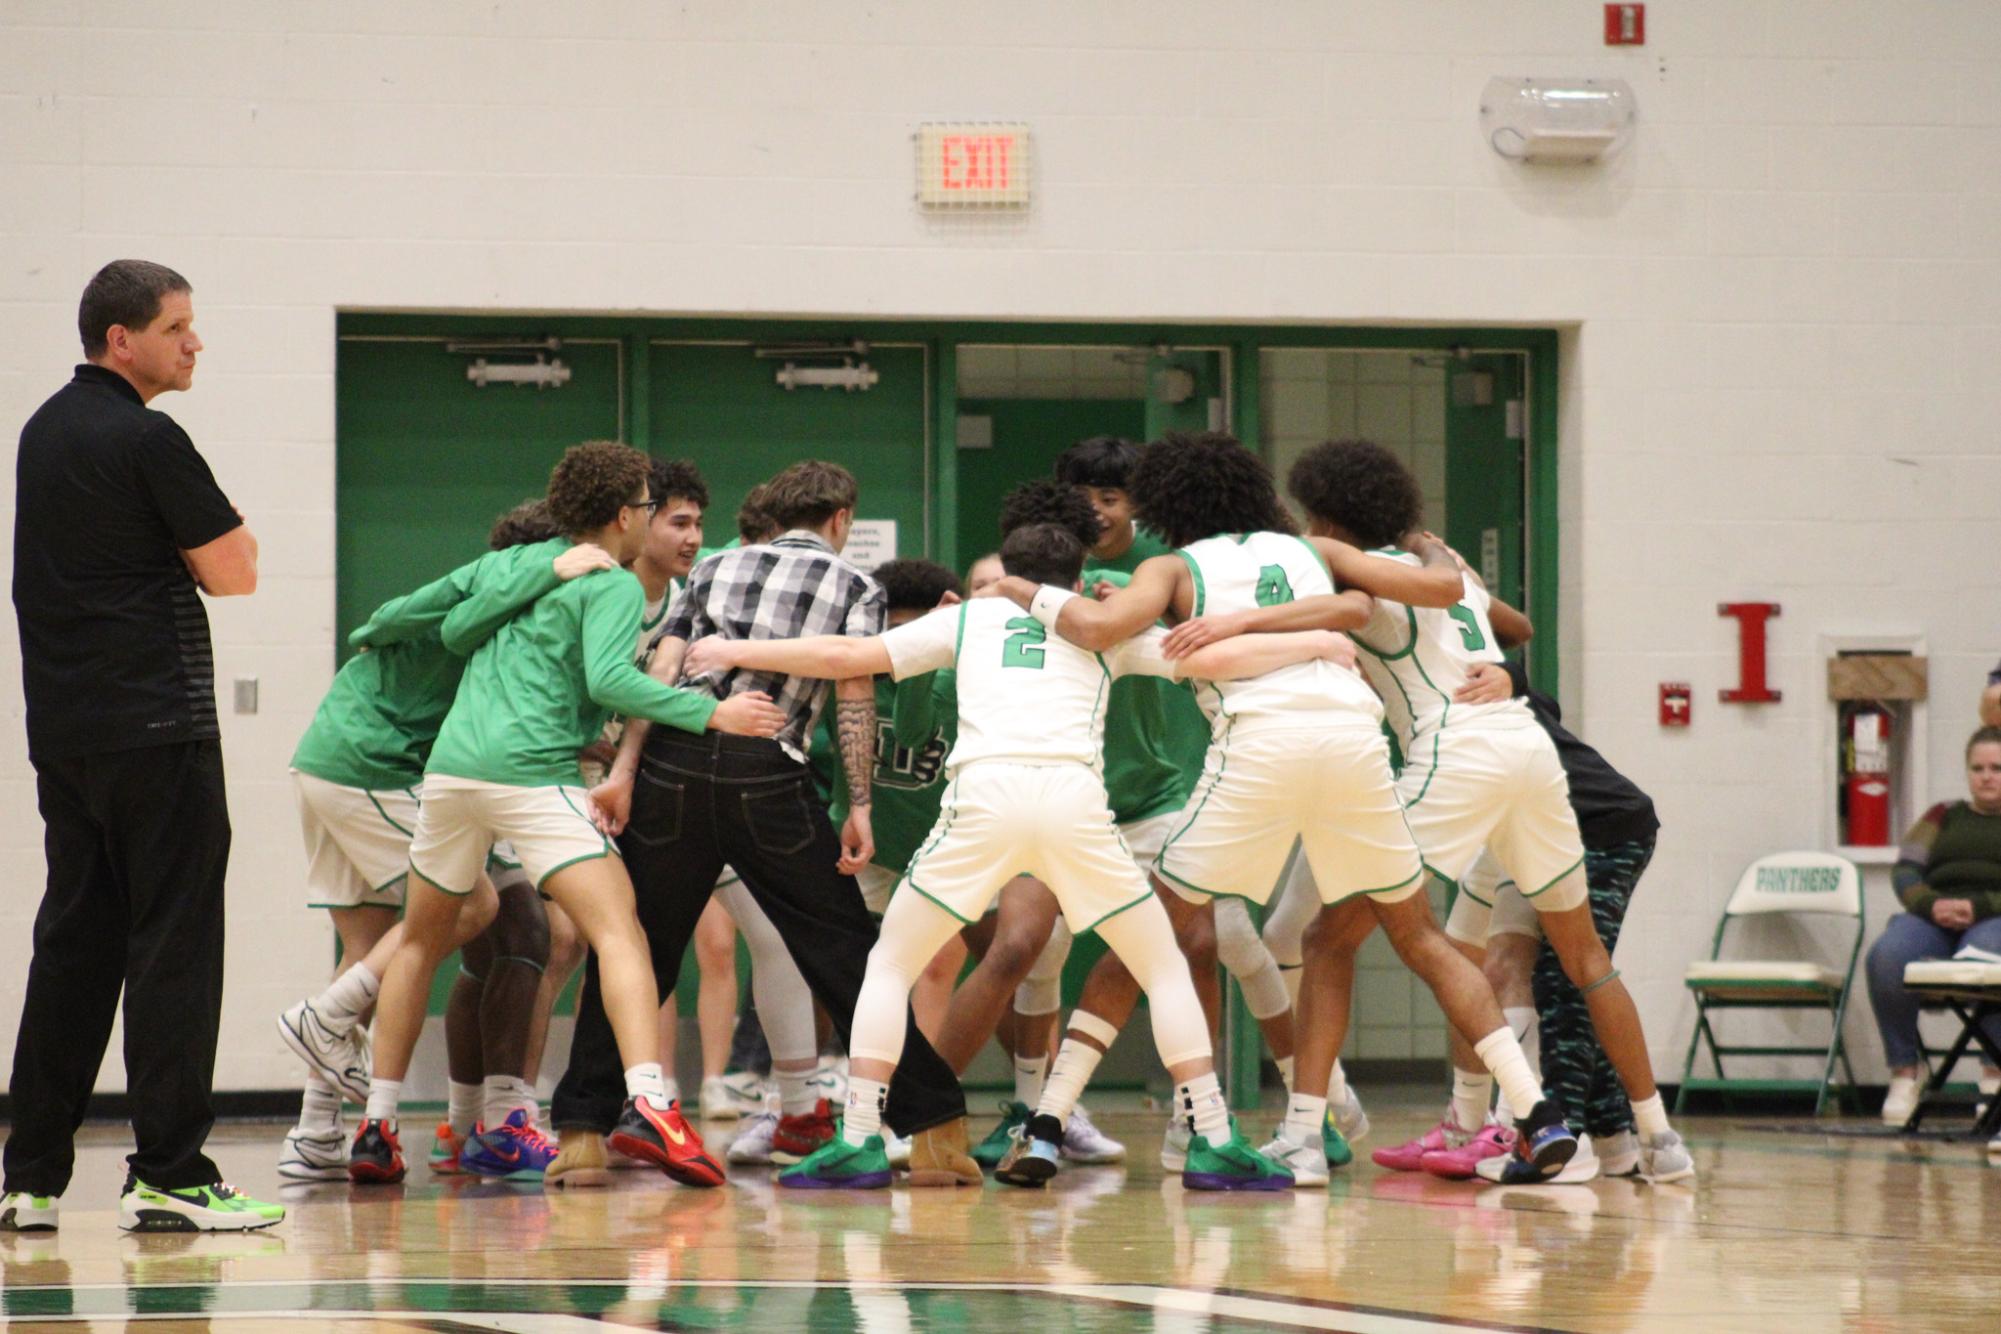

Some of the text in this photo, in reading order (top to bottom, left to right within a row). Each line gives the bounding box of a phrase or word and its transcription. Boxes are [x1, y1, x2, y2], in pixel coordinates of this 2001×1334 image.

[942, 134, 1013, 189] EXIT
[1002, 616, 1046, 669] 2
[1756, 866, 1842, 893] PANTHERS
